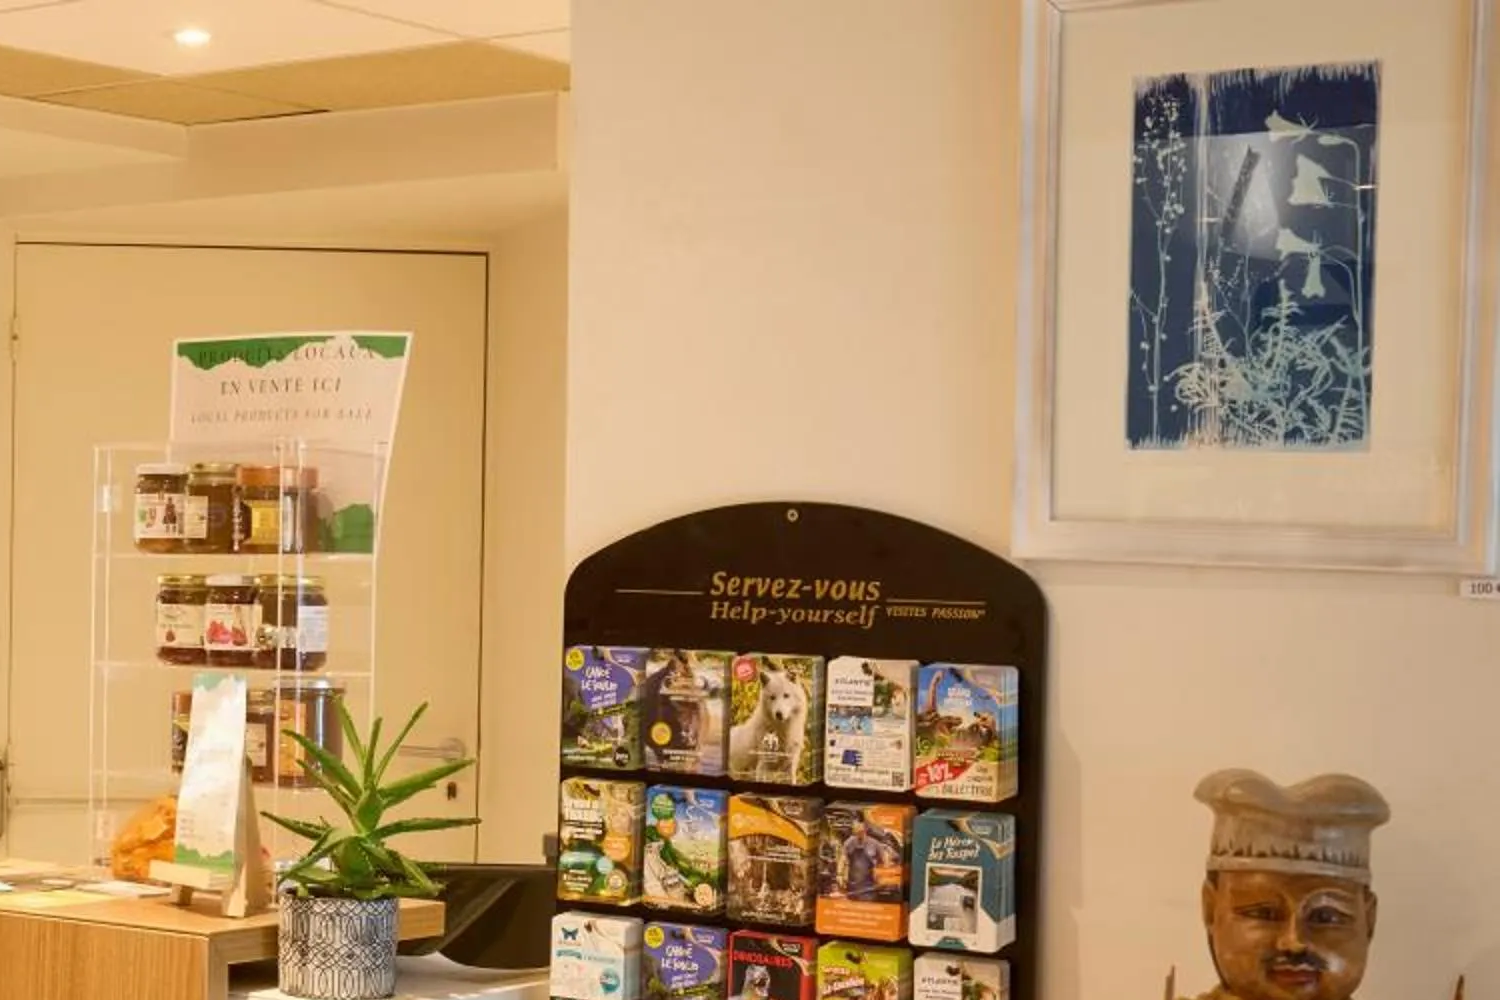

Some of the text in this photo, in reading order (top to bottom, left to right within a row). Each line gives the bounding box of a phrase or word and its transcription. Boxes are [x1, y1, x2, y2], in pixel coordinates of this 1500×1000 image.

[219, 376, 342, 396] EN VENTE ICI
[710, 570, 882, 602] Servez-vous
[1469, 582, 1494, 595] 100
[710, 600, 882, 629] Help-yourself
[886, 607, 927, 617] VISITES
